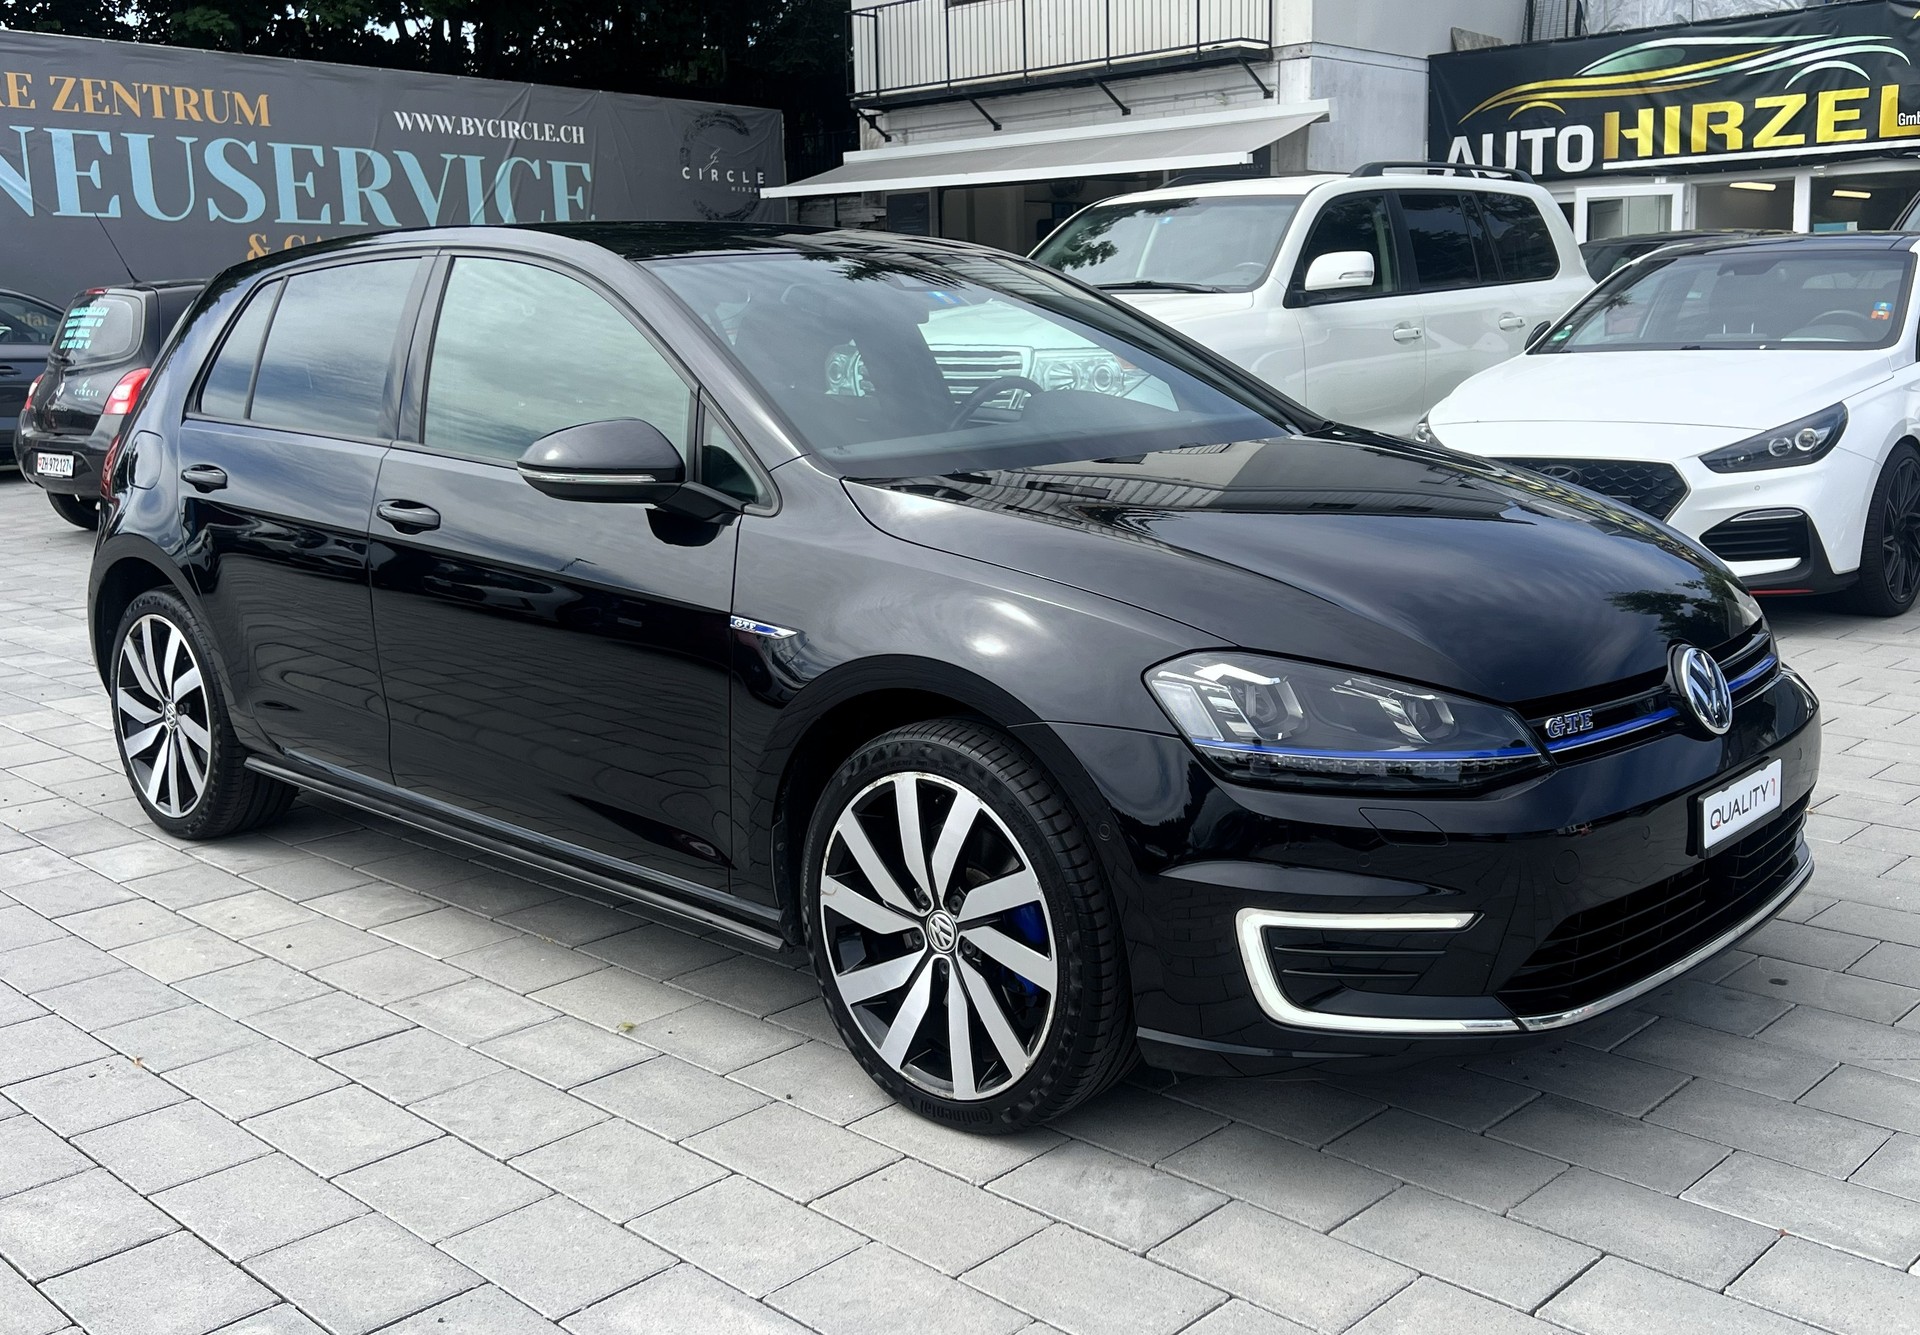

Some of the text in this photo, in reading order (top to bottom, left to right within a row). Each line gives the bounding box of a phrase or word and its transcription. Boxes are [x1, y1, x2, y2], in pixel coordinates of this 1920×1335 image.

[0, 71, 272, 127] E ZENTRUM
[393, 111, 585, 144] WWW.BYCIRCLE.CH
[1443, 124, 1594, 178] AUTO
[1603, 84, 1920, 160] HIRZEL
[682, 167, 765, 184] CIRCLE
[734, 619, 757, 632] GTE
[1545, 709, 1594, 739] GTE
